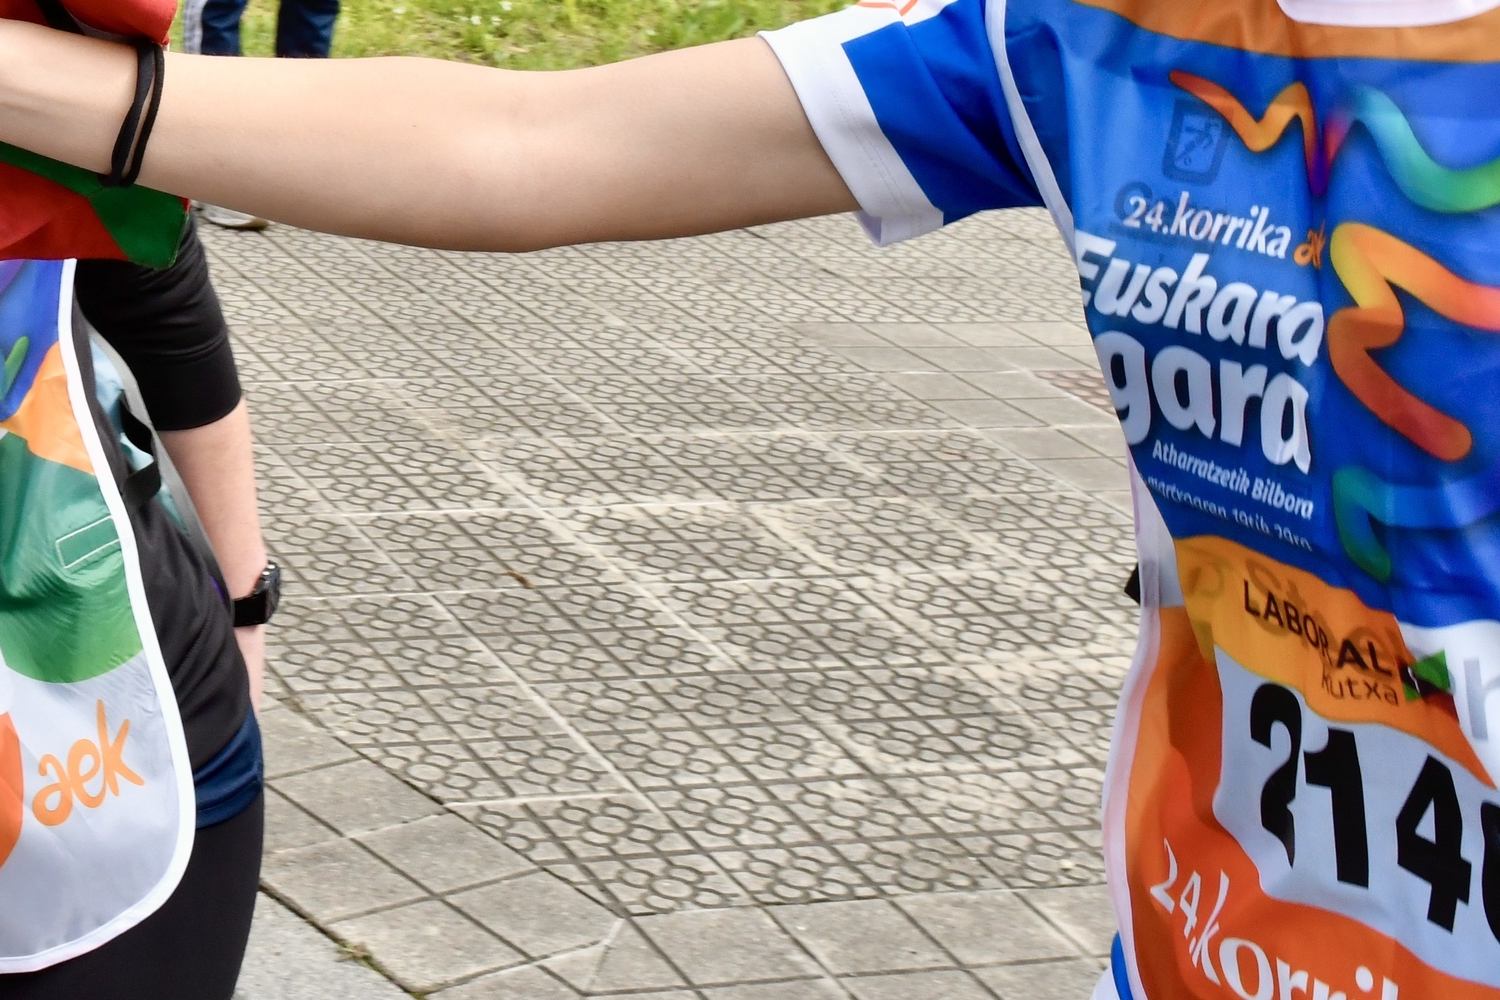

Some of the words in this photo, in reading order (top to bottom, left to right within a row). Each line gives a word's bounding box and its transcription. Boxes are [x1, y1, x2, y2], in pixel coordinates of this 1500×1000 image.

[1122, 190, 1291, 260] 24.korrika
[1074, 229, 1324, 367] Euskara
[1094, 330, 1311, 475] gara
[1152, 439, 1250, 495] Atharratzetik
[1243, 579, 1393, 677] LABORAL
[1322, 664, 1399, 706] kutxa
[32, 699, 145, 827] aek
